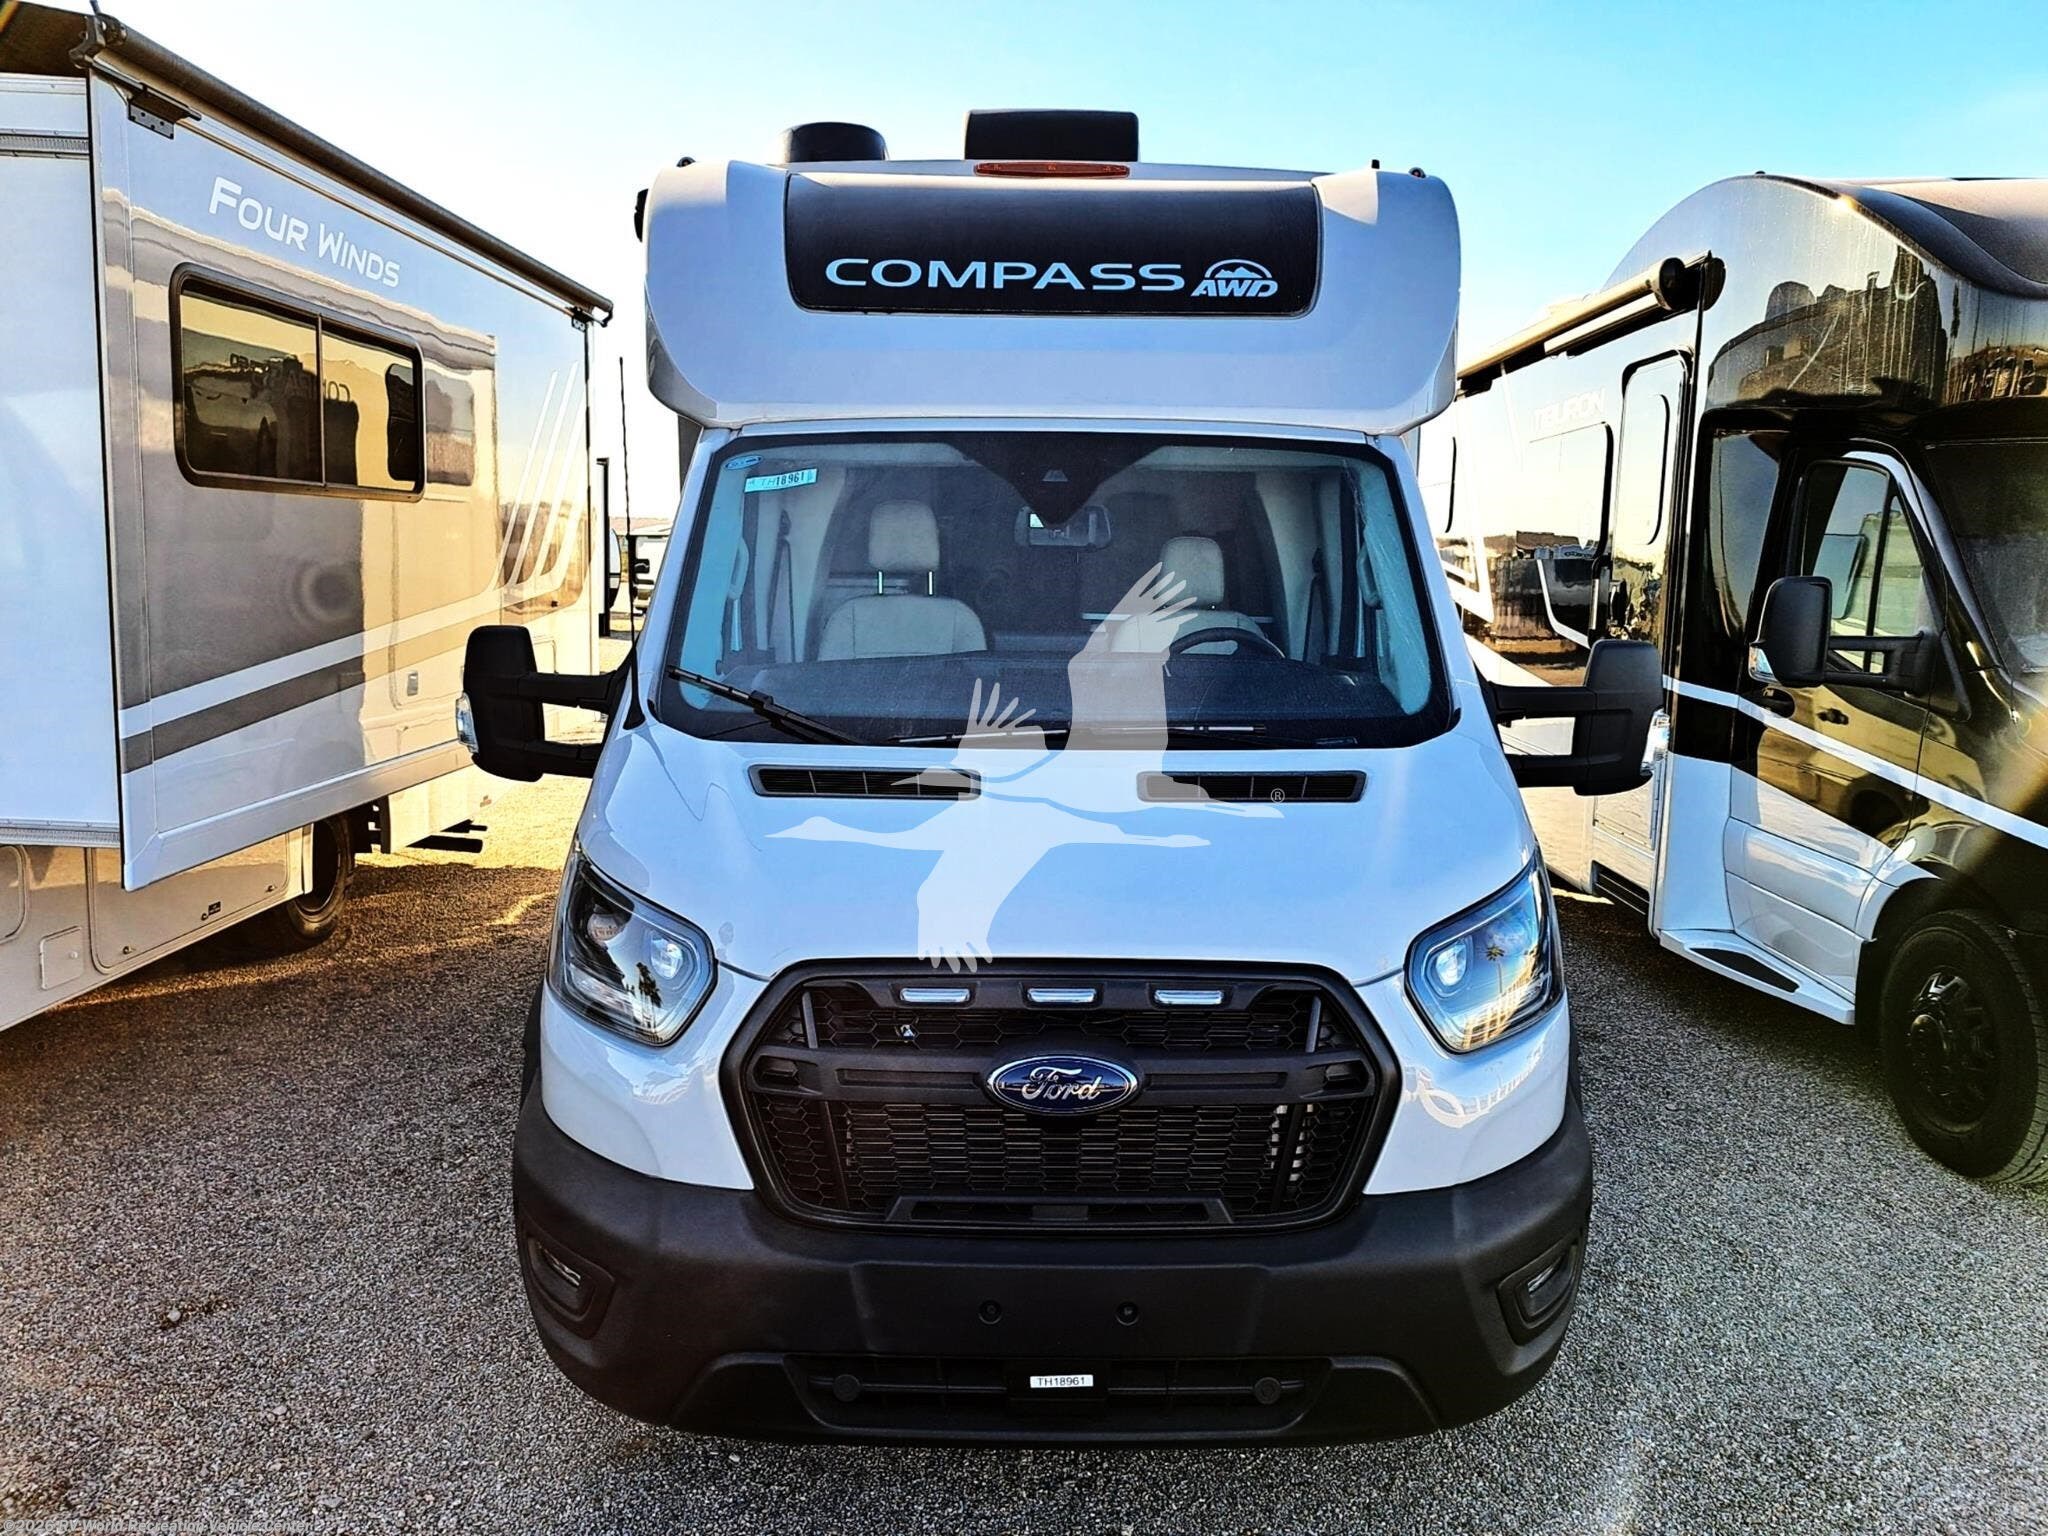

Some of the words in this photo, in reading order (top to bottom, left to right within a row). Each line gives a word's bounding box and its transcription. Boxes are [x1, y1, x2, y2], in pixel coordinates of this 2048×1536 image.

[825, 258, 1185, 291] COMPASS
[1191, 277, 1279, 298] AWD
[1021, 1066, 1103, 1100] Ford
[1037, 1376, 1085, 1386] TH18961
